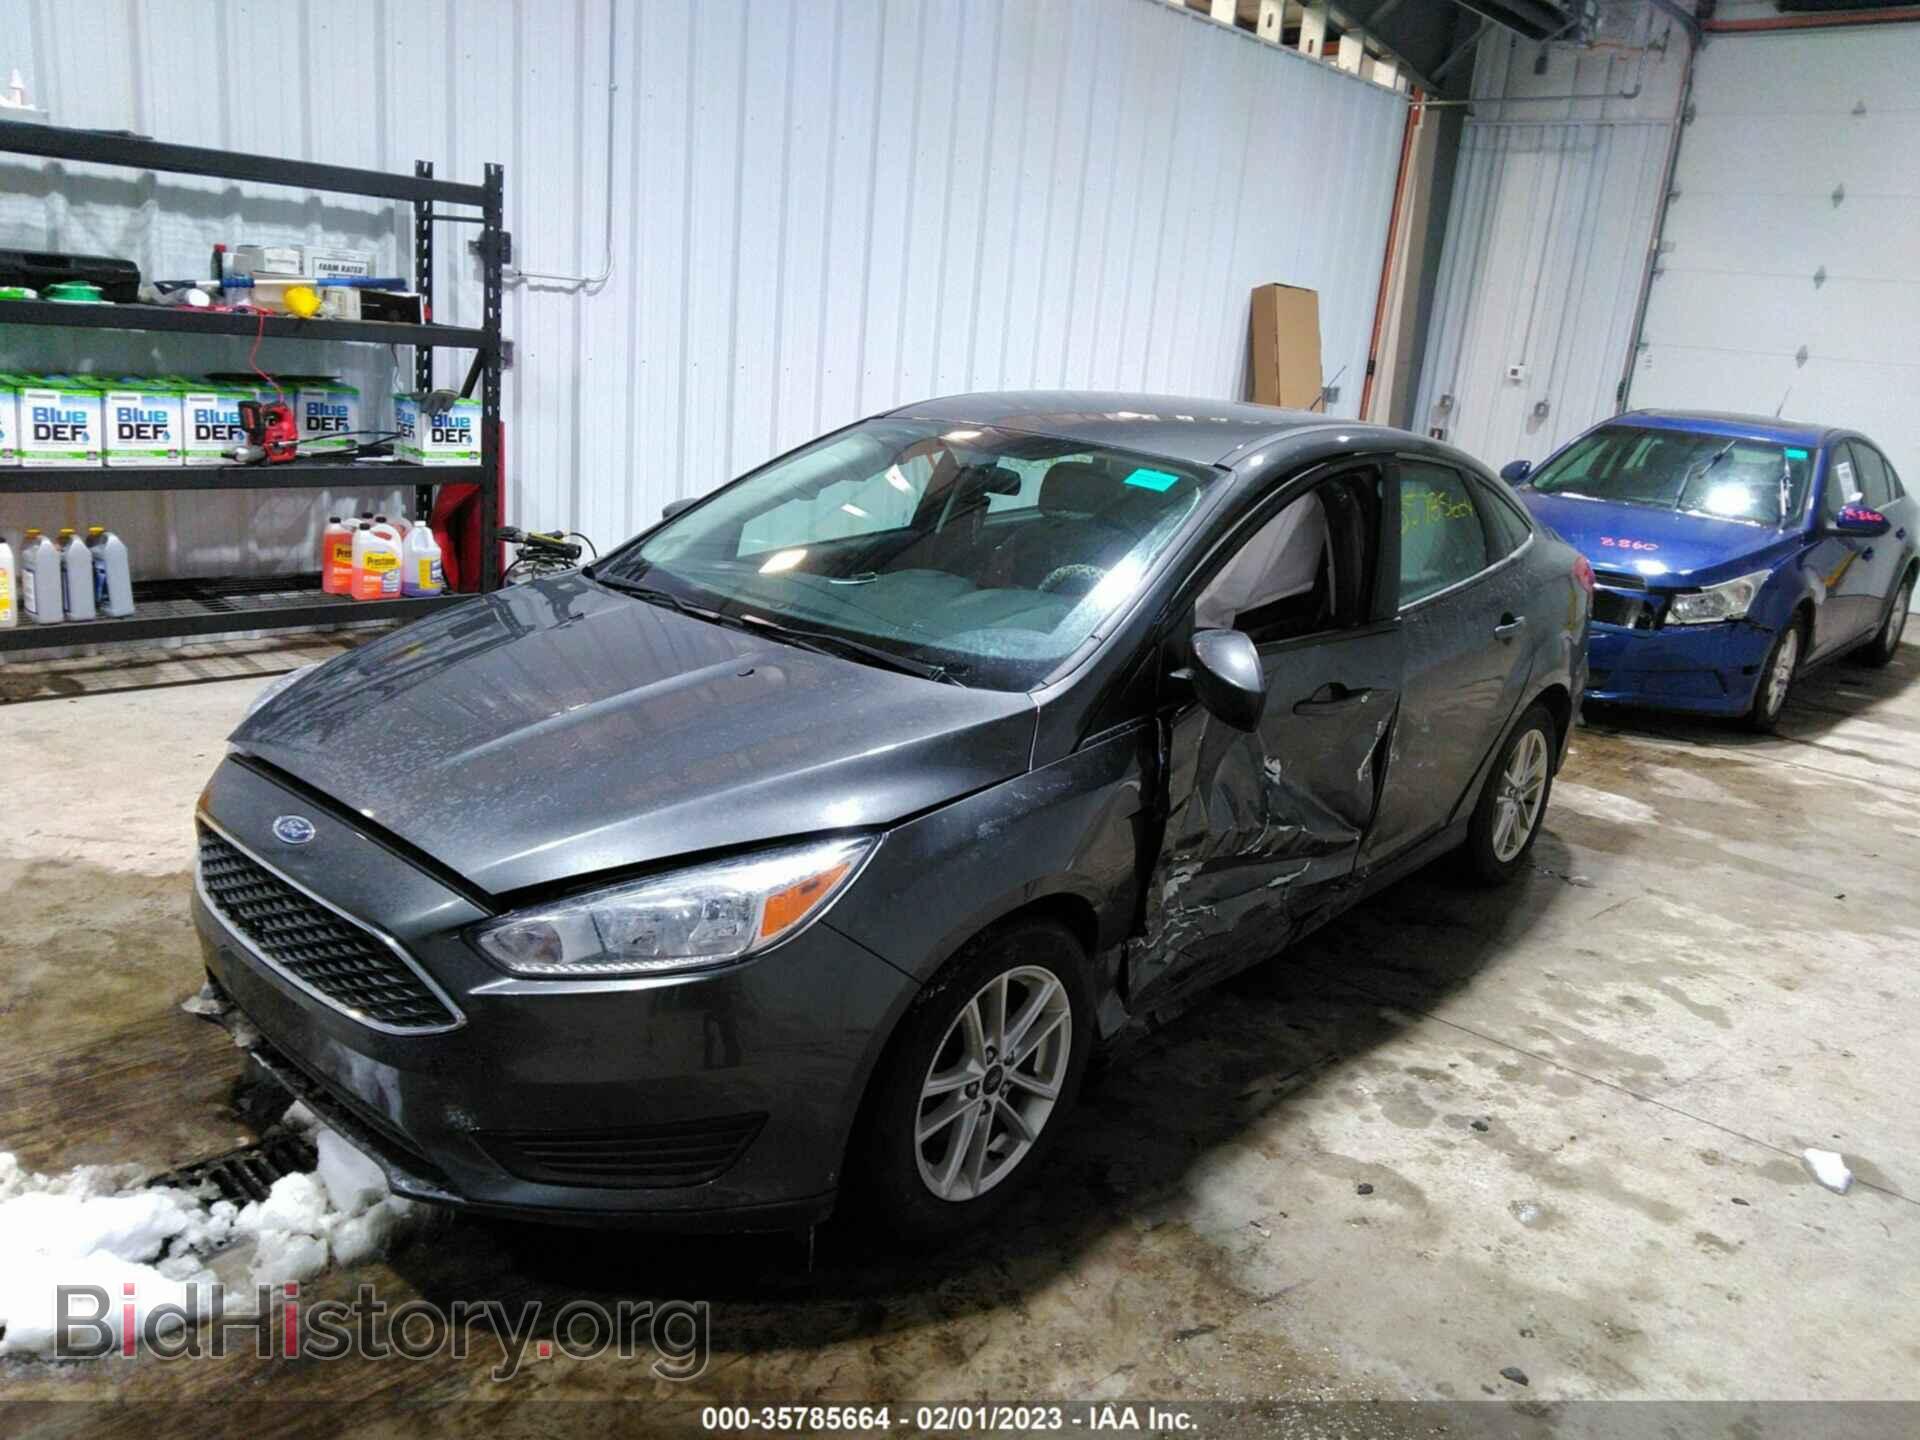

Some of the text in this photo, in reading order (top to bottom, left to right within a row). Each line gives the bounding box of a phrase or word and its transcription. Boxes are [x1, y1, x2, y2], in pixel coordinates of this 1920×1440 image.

[32, 407, 87, 423] Blue
[117, 407, 168, 423] Blue
[195, 408, 241, 424] Blue
[306, 402, 348, 416] Blue
[306, 416, 348, 431] DEF
[431, 414, 471, 428] Blue
[34, 424, 87, 441] DEF
[118, 424, 167, 440] DEF
[195, 424, 241, 441] DEF
[432, 428, 471, 443] DEF
